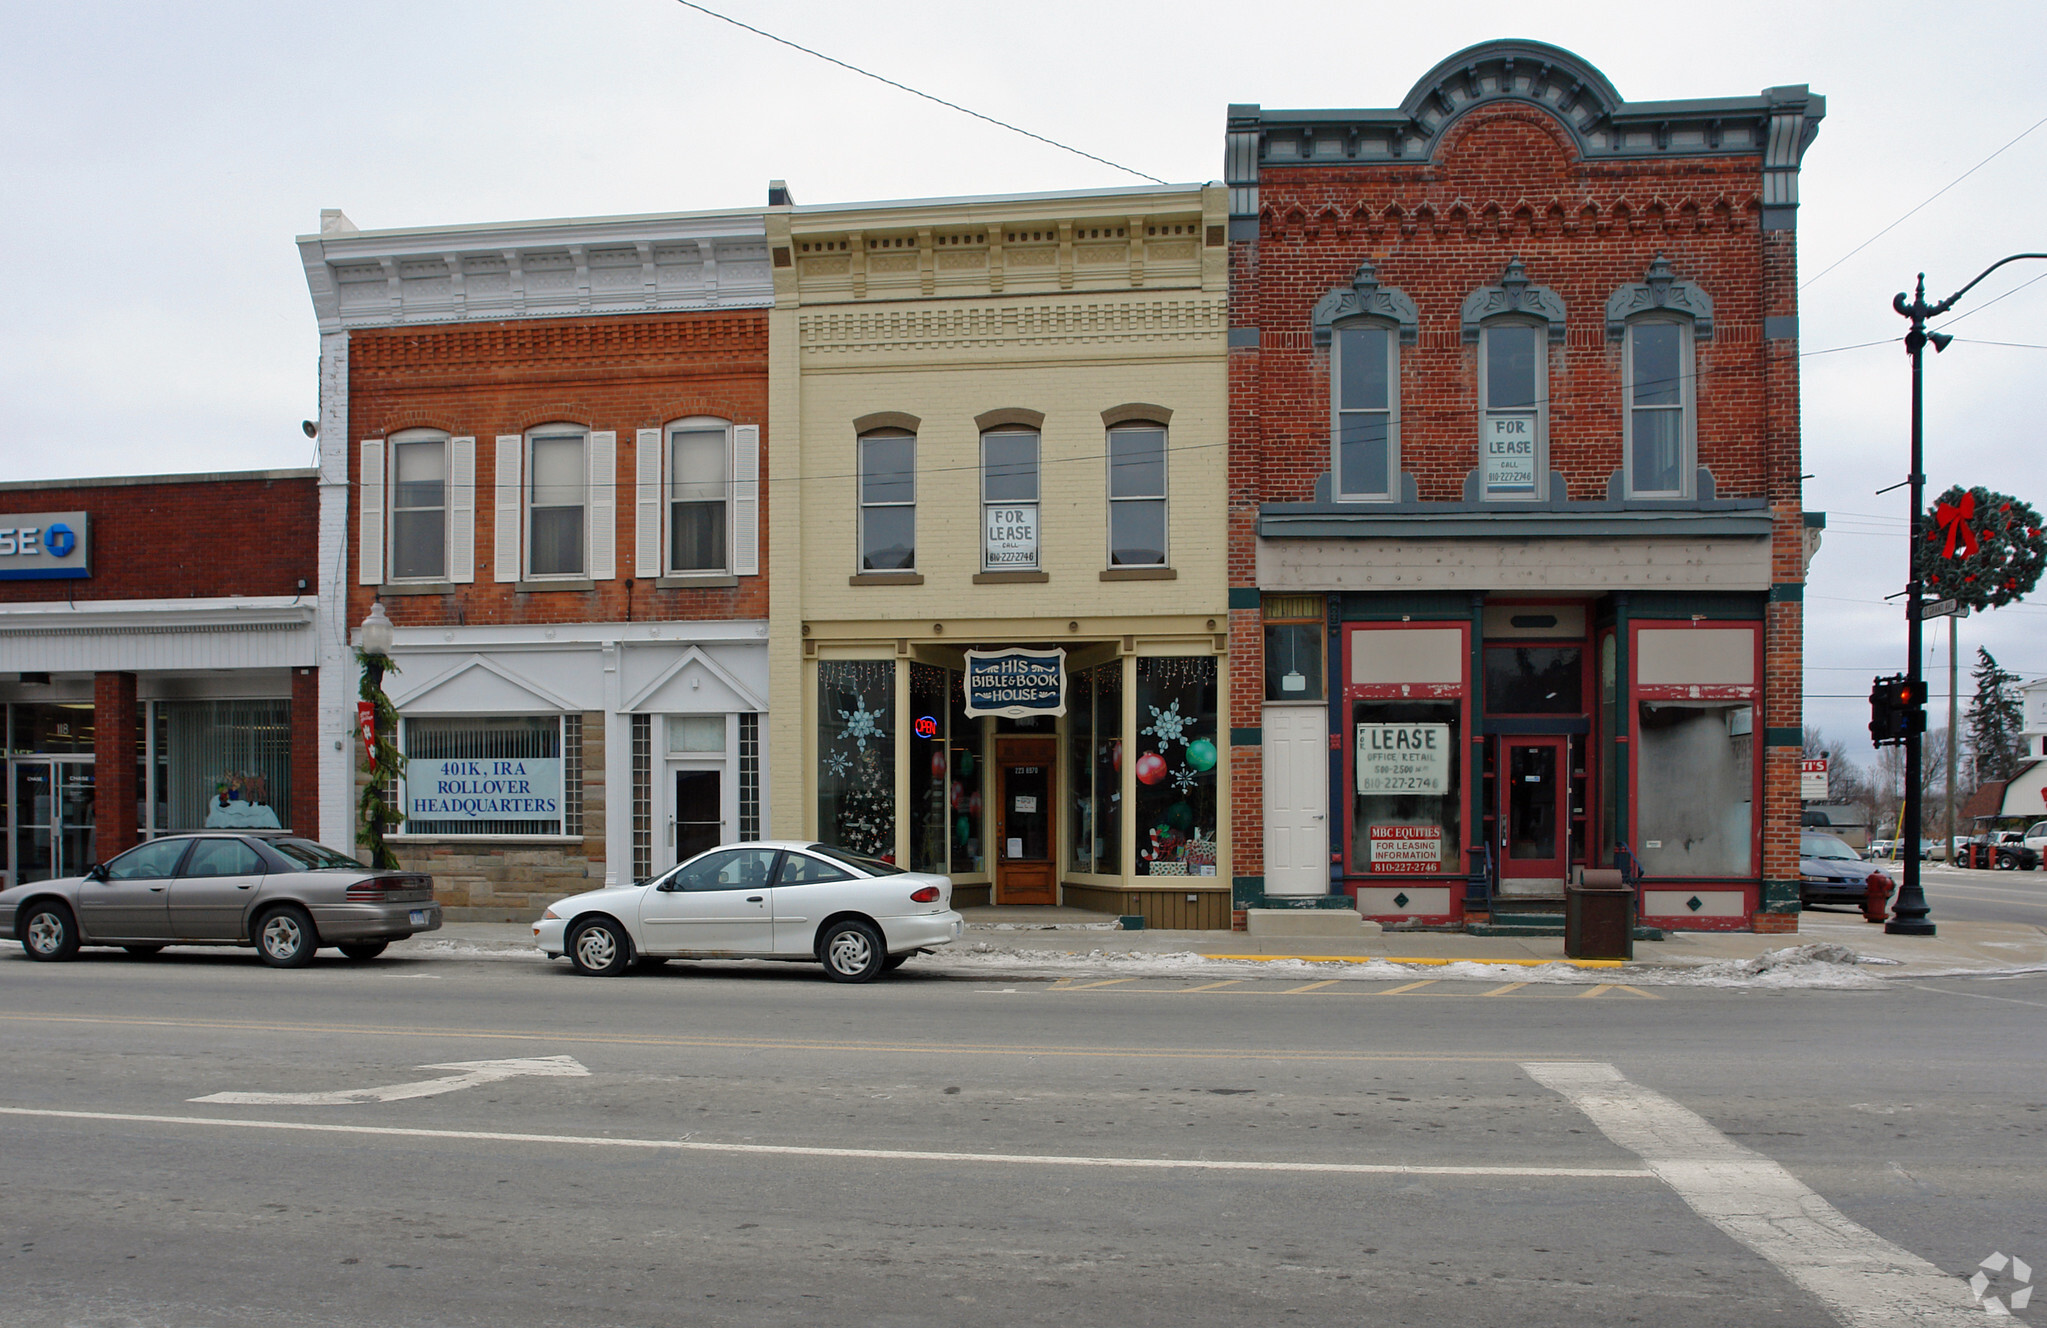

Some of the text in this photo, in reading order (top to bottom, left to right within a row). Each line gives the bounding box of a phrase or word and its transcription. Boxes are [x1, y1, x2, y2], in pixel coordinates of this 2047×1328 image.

[1496, 421, 1526, 434] FOR
[1489, 441, 1531, 454] LEASE
[1488, 472, 1531, 481] 810-227-2746
[995, 510, 1025, 523] FOR
[990, 525, 1032, 541] LEASE
[0, 527, 40, 555] SE
[1945, 601, 1954, 611] AVE
[1001, 660, 1029, 673] HIS
[992, 688, 1037, 701] HOUSE
[56, 723, 69, 735] 118
[915, 718, 936, 735] OPEN
[1372, 729, 1437, 749] LEASE
[1402, 753, 1436, 762] RETAIL
[440, 761, 526, 778] 401K, IRA
[1375, 765, 1413, 774] 500-2500
[437, 780, 530, 794] ROLLOVER
[1364, 777, 1439, 789] 810-227-2746
[414, 798, 556, 816] HEADQUARTERS
[1372, 828, 1440, 839] MBC EQUITIES
[1376, 842, 1435, 850] FOR LEASING
[1375, 851, 1437, 859] INFORMATION
[1374, 863, 1437, 872] 810-227-2746
